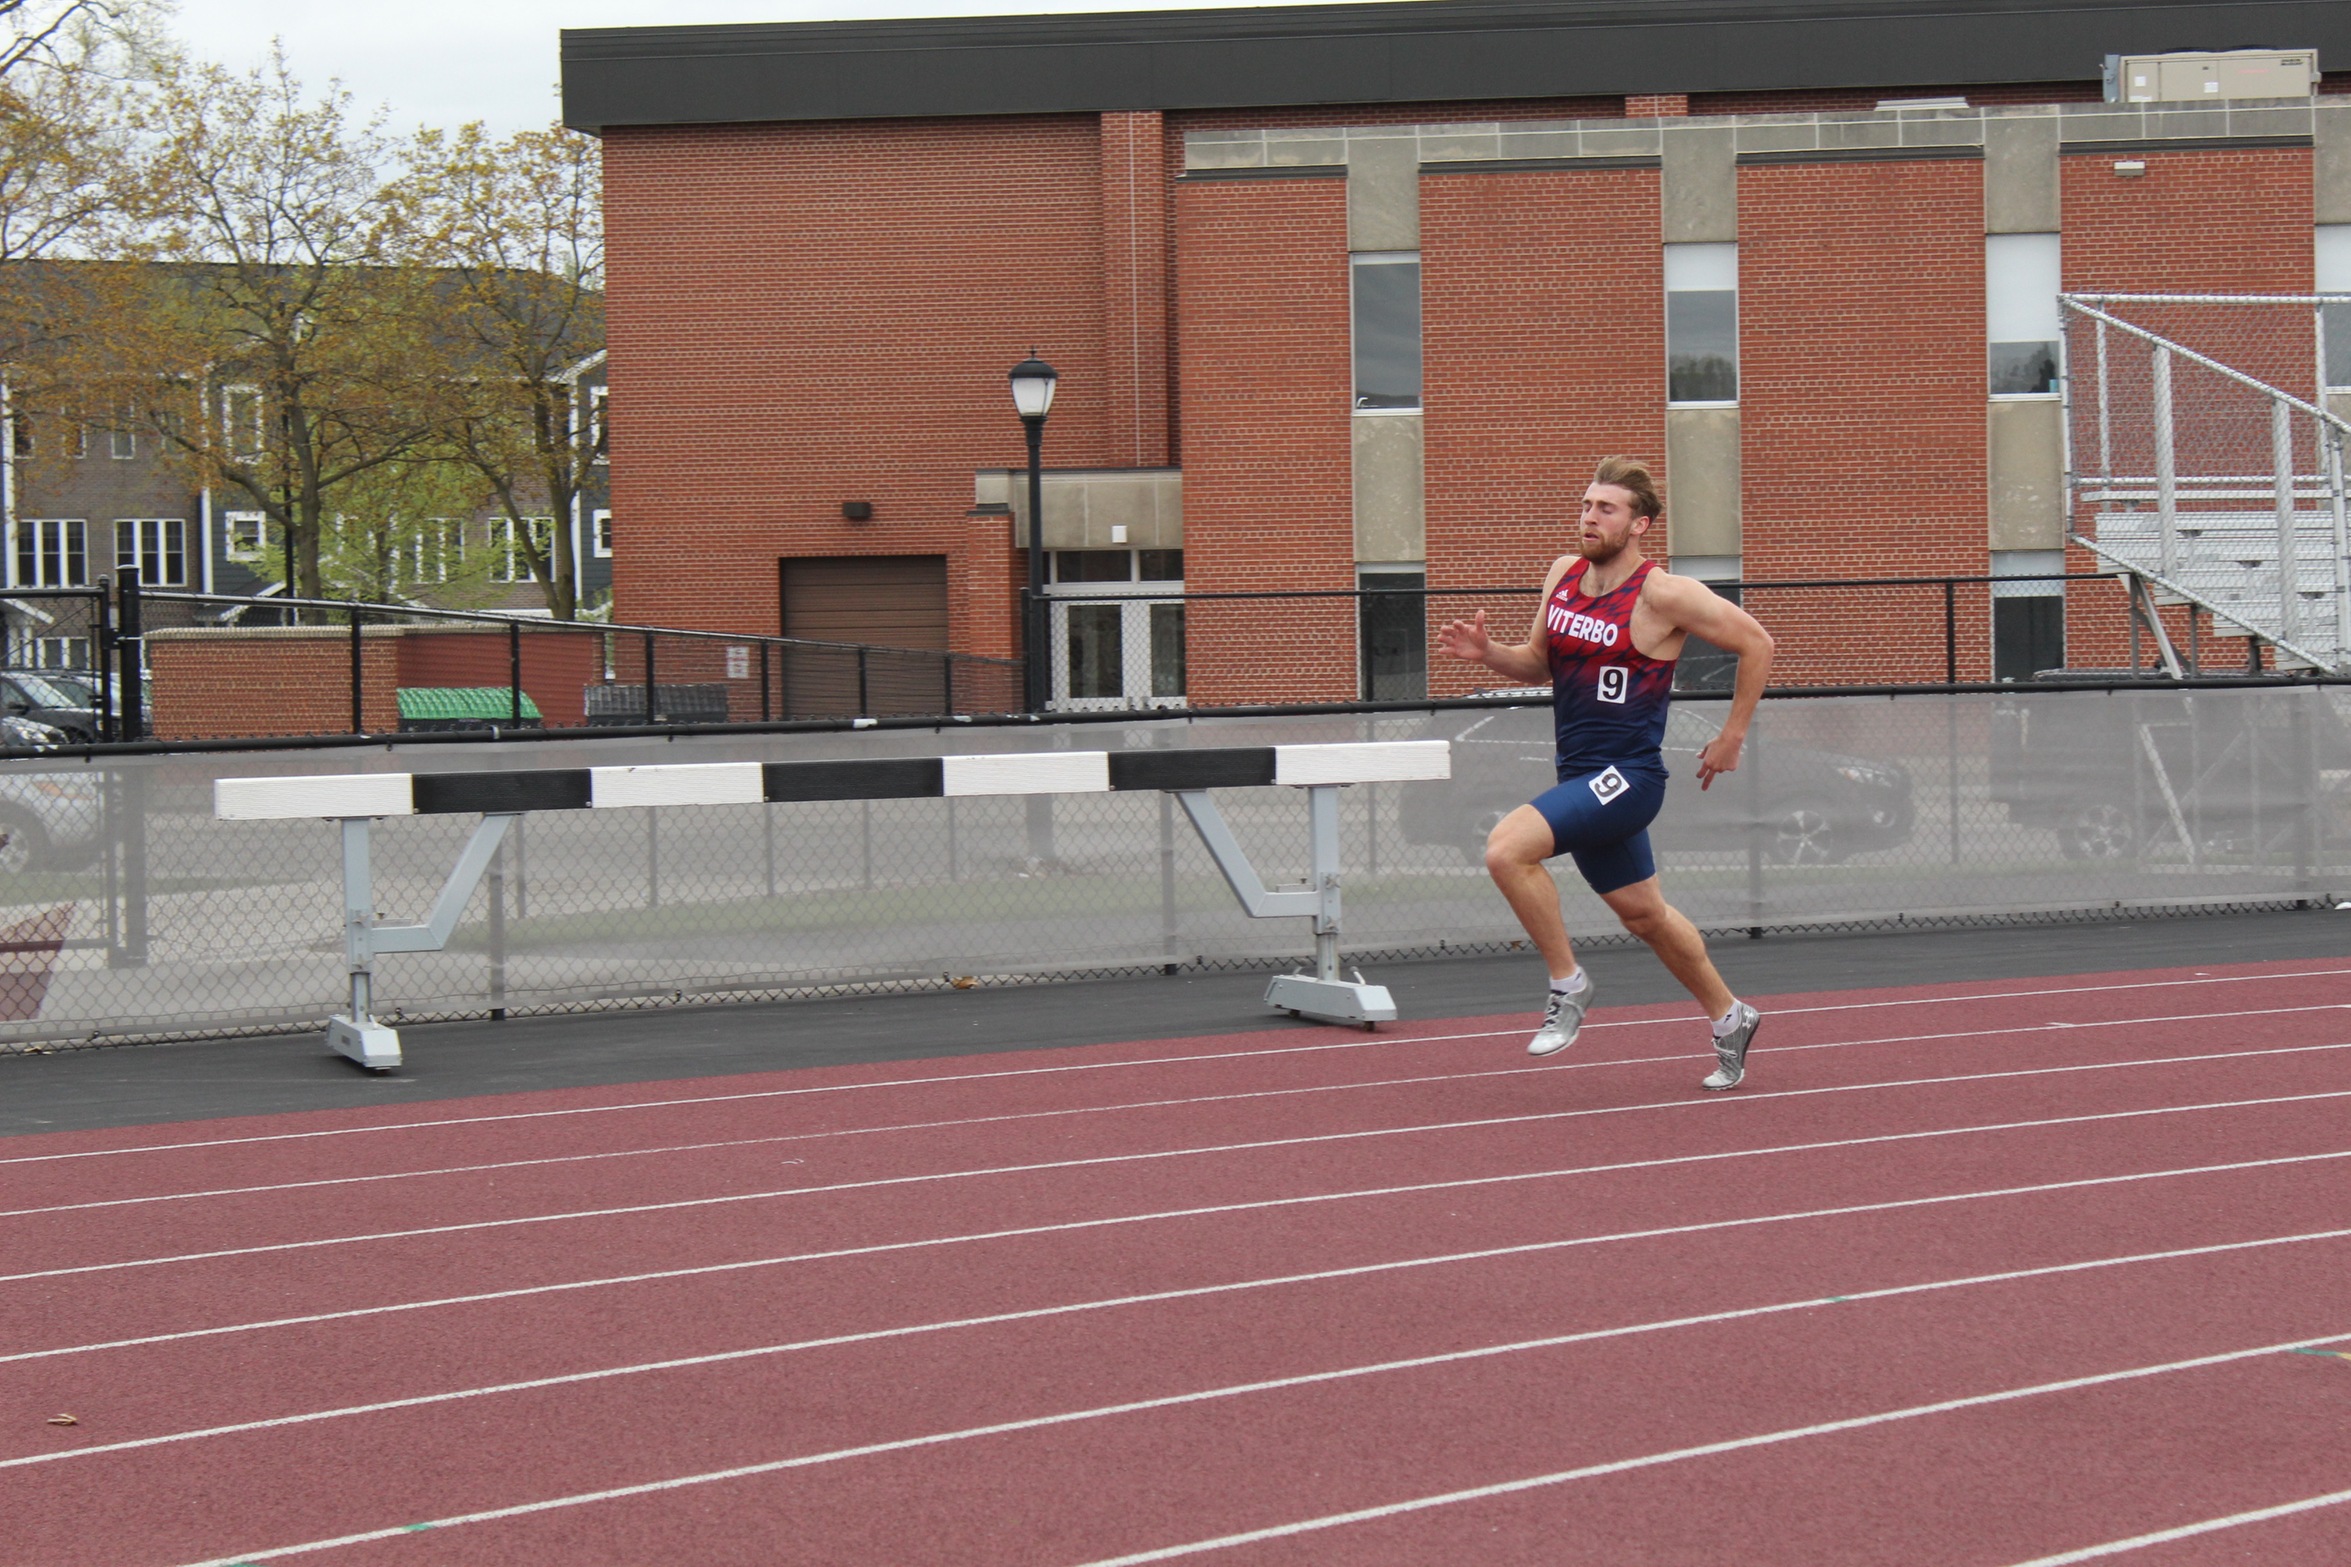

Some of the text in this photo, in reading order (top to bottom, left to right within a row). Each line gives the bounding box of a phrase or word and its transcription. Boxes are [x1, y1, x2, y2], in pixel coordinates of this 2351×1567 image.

[1547, 604, 1619, 647] VITERBO
[1602, 668, 1624, 700] 9
[1594, 772, 1622, 798] 9
